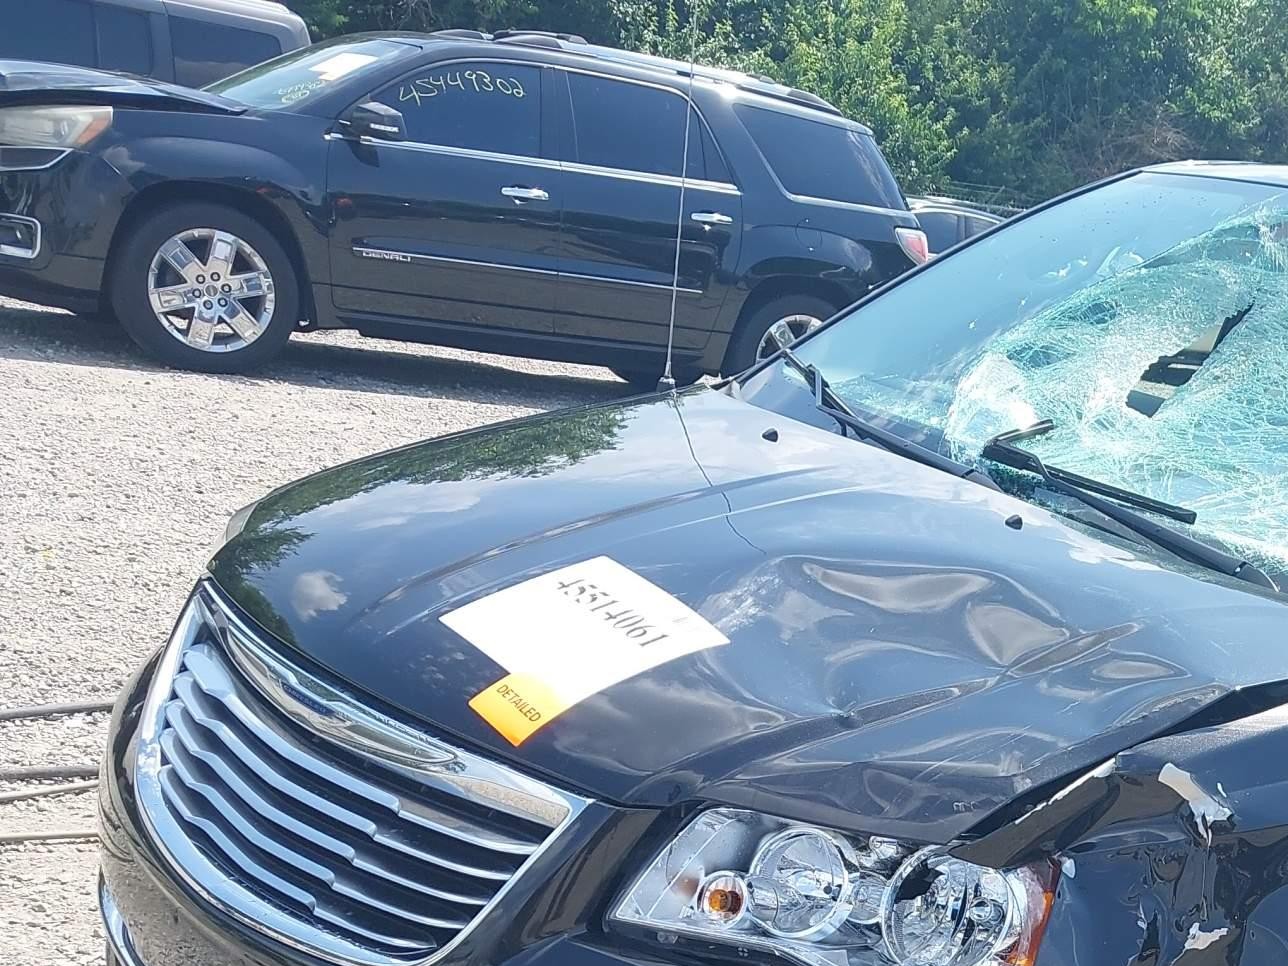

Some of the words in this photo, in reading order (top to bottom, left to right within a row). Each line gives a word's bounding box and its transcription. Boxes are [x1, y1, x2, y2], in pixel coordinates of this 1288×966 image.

[399, 70, 527, 107] 45449302
[362, 250, 411, 262] DENALI
[557, 579, 670, 648] 45514061
[496, 684, 542, 723] DETAILED
